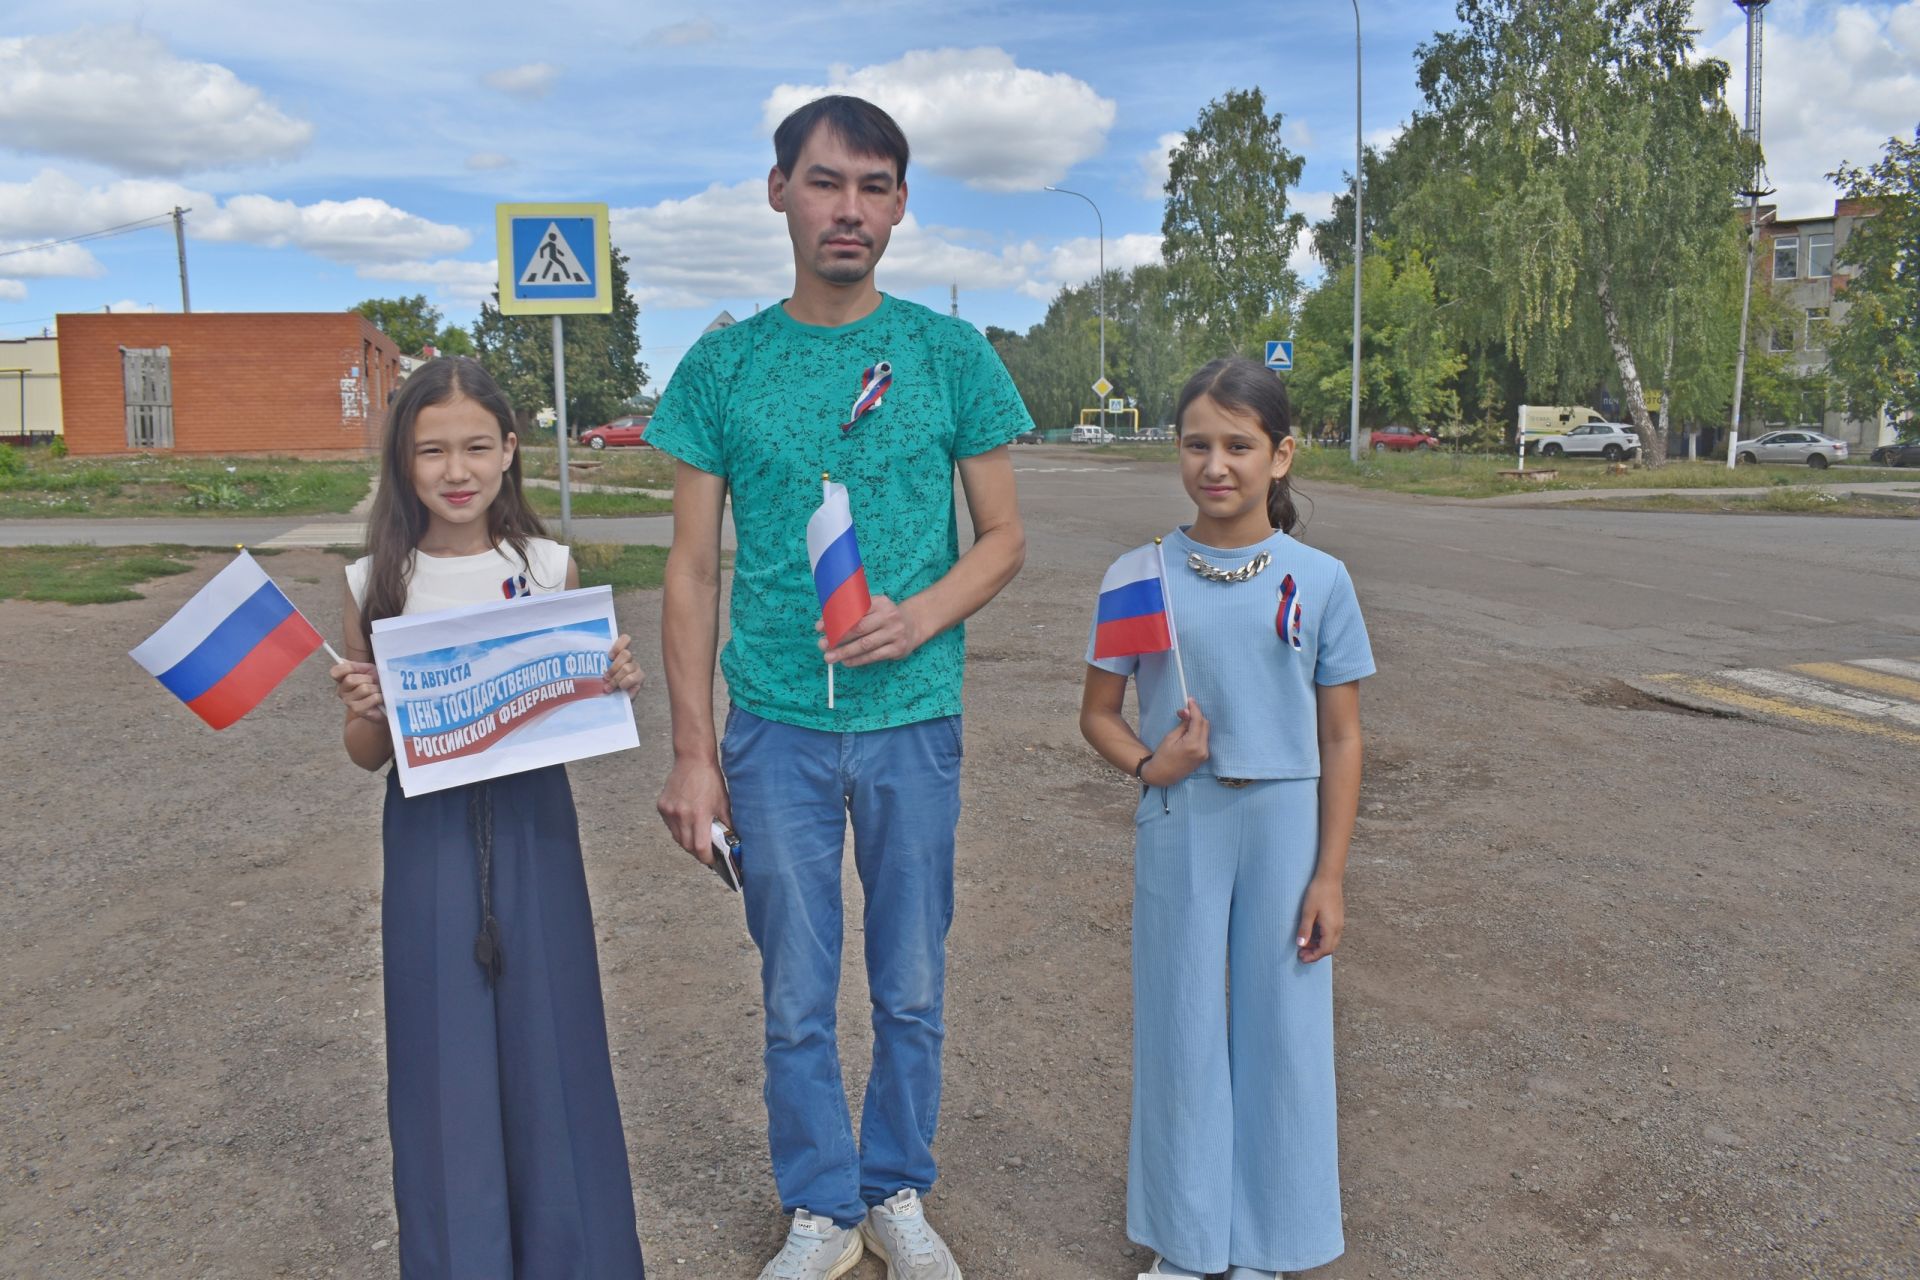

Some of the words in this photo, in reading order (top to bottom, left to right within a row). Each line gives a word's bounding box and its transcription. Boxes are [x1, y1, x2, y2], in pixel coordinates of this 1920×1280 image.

[400, 670, 418, 690] 22
[420, 662, 472, 689] АВГУСТА
[406, 700, 441, 733] ДЕНЬ
[442, 657, 562, 723] ГОСУДАРСТВЕННОГО
[565, 653, 608, 676] ФЛАГА
[413, 713, 497, 757] РОССИЙСКОЙ
[499, 680, 576, 724] ФЕДЕРАЦИИ
